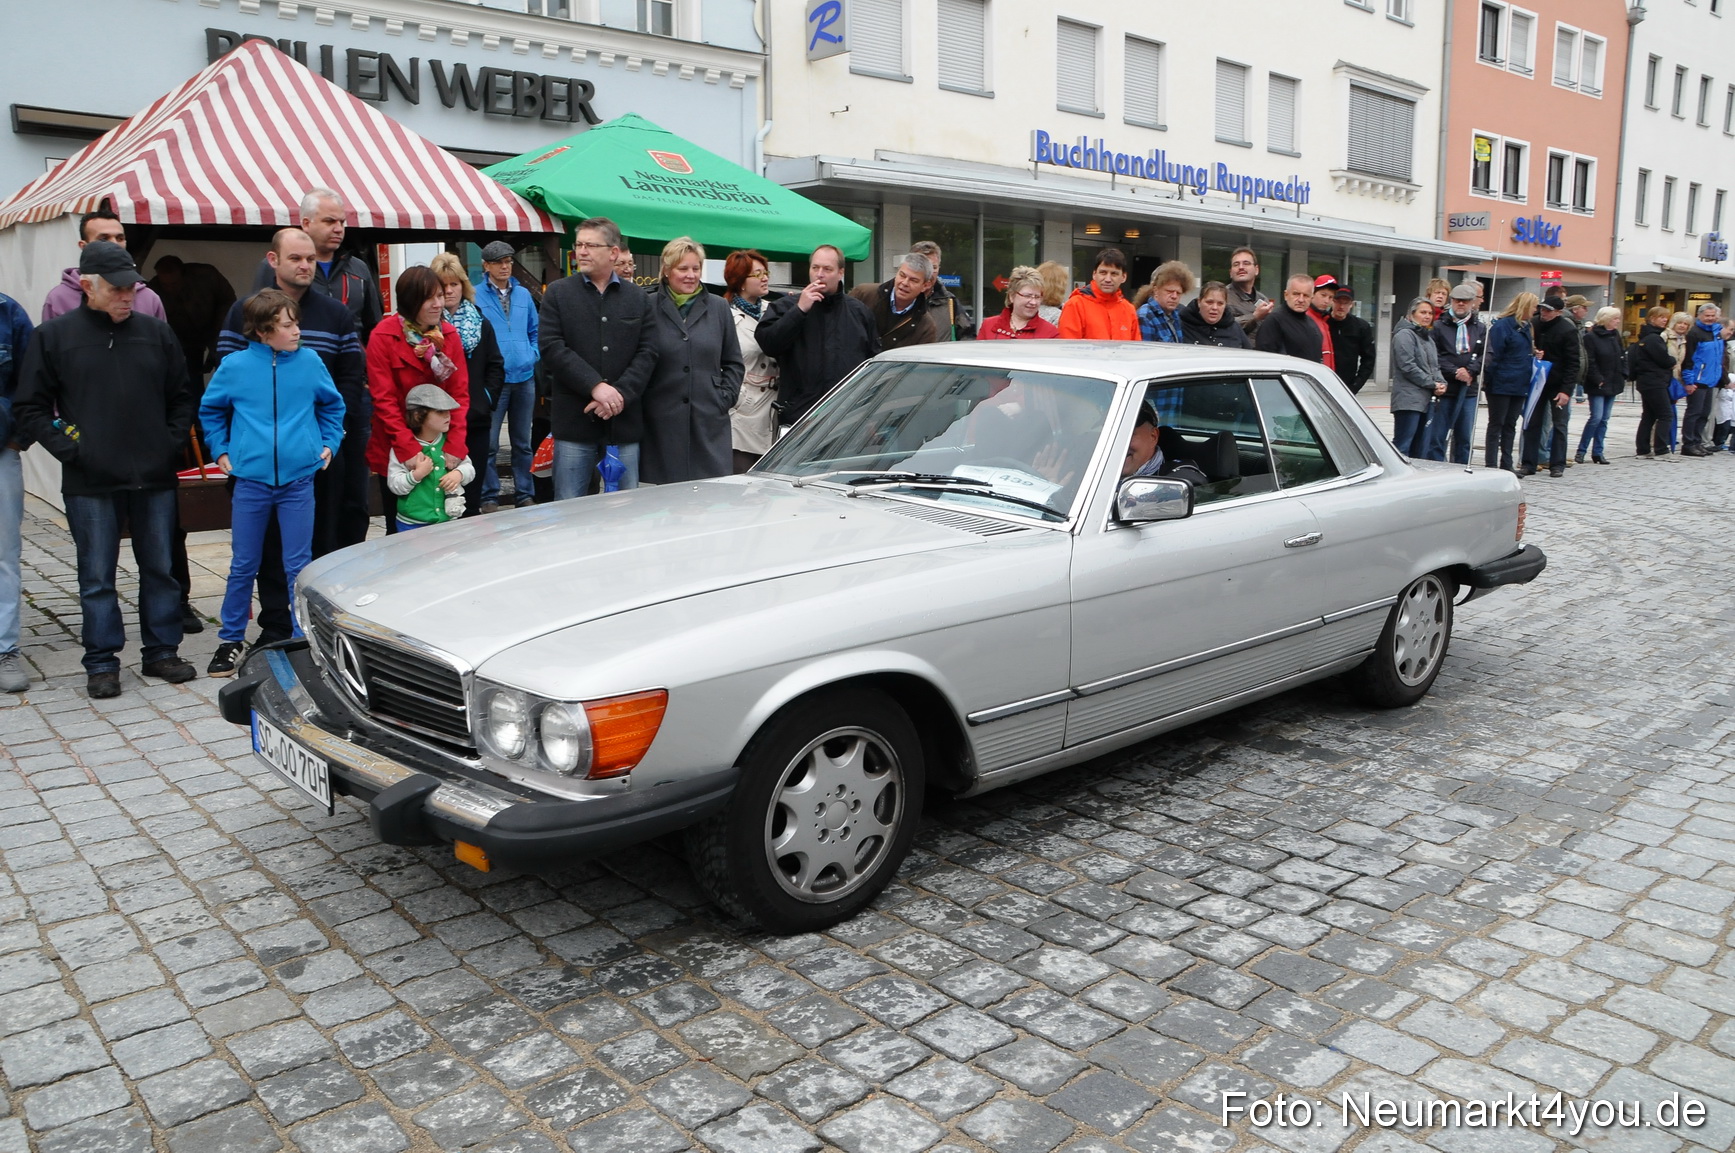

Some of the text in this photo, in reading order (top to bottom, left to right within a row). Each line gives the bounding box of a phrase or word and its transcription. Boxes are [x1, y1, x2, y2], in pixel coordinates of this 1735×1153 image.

[204, 28, 604, 125] BLEN WEBER
[634, 170, 740, 192] Neumarkter
[1031, 129, 1311, 204] Buchhandlung Rupprecht
[618, 175, 772, 206] Lammsbräu
[258, 719, 274, 759] SC
